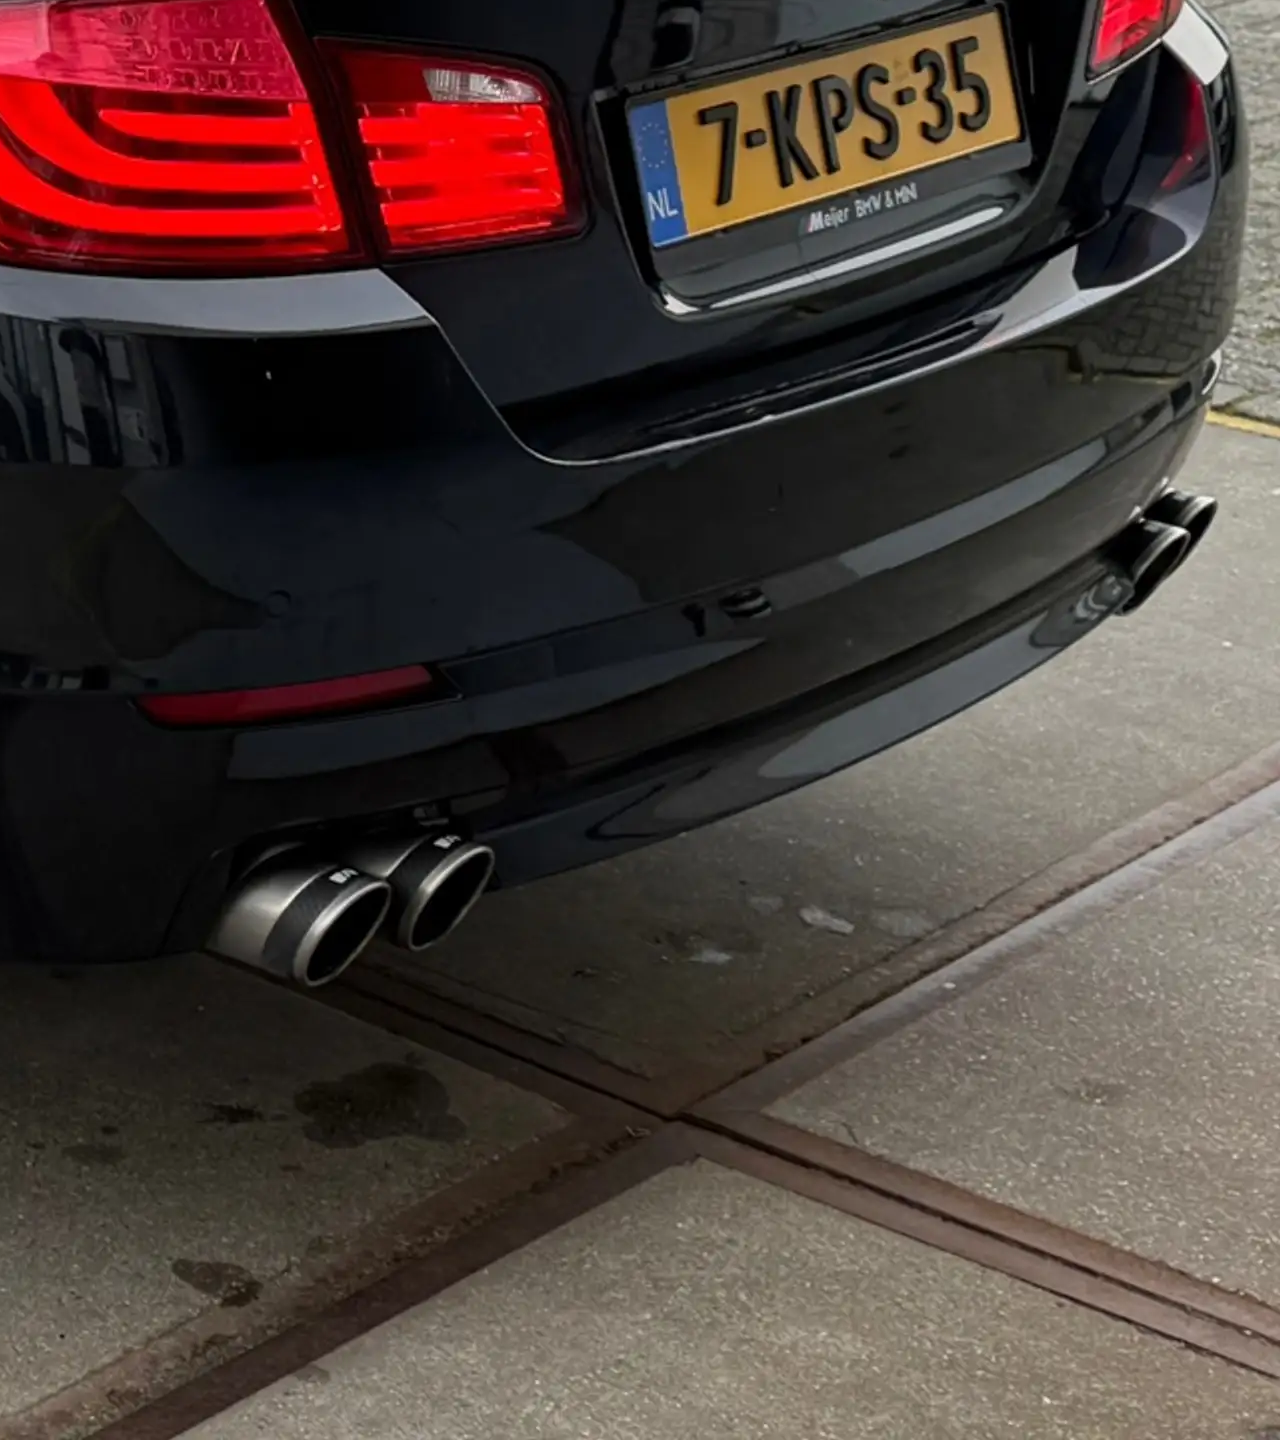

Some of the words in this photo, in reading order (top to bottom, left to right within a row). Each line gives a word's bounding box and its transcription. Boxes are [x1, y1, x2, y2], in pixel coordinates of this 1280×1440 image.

[697, 35, 992, 208] 7-KPS-35
[645, 187, 679, 222] NL
[807, 205, 850, 233] Meijer
[854, 192, 882, 218] BMW
[884, 190, 895, 208] &
